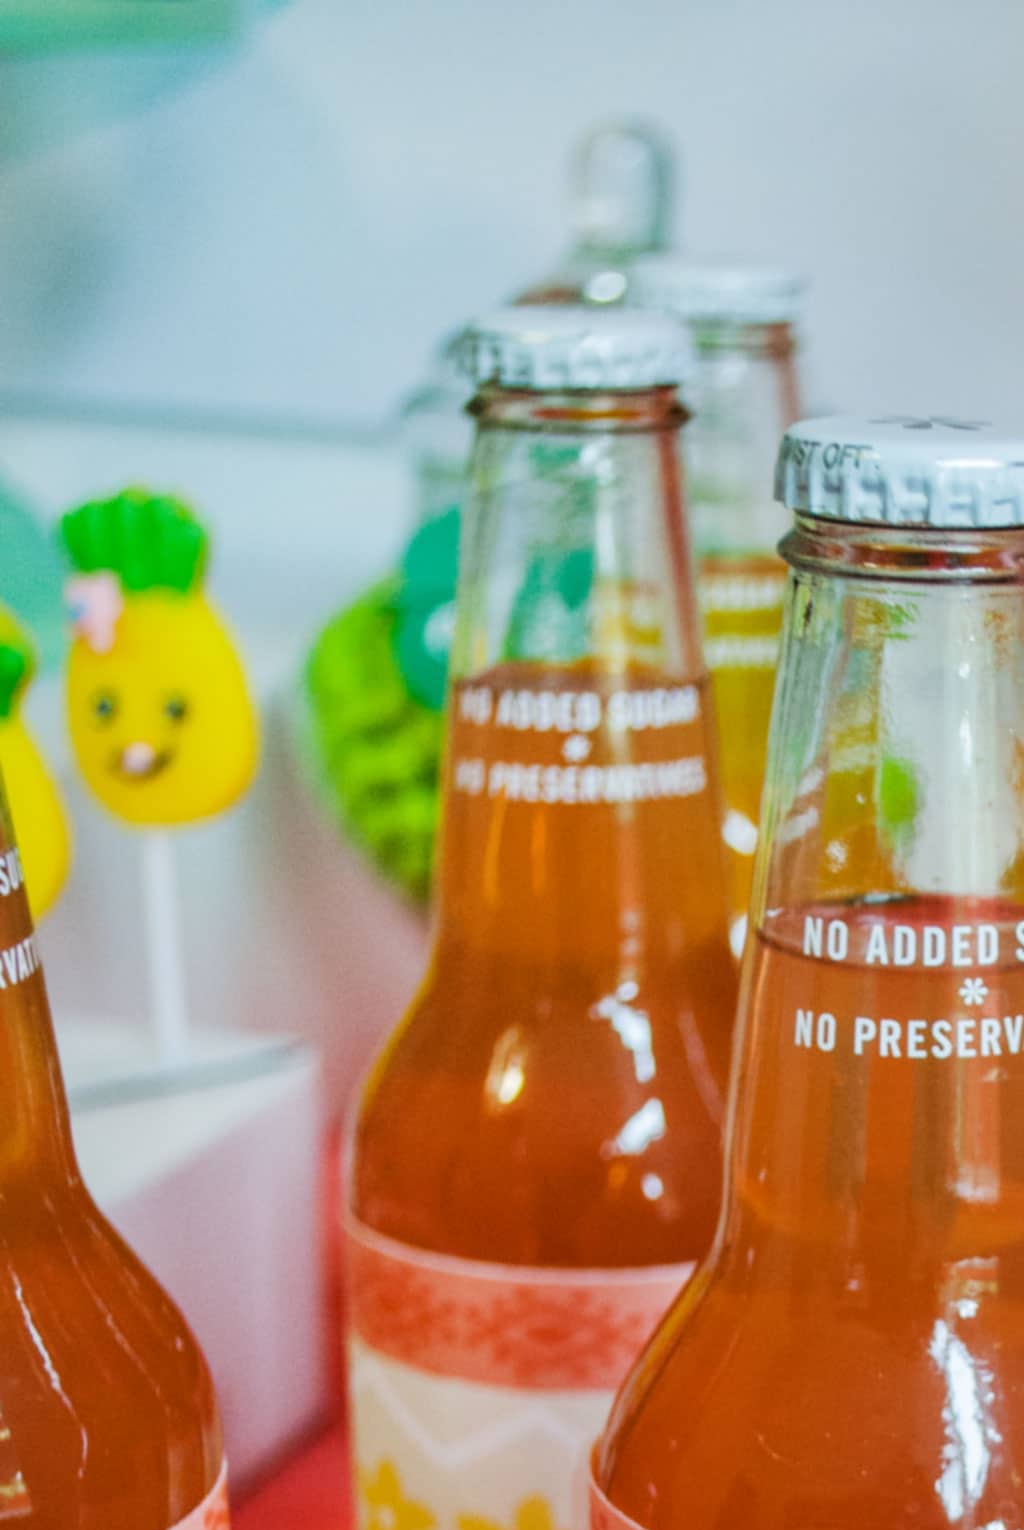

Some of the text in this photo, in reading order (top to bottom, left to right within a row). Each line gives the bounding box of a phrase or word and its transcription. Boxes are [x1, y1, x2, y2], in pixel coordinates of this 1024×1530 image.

[803, 915, 849, 960] NO
[865, 922, 1000, 967] ADDED
[793, 1008, 836, 1052] NO
